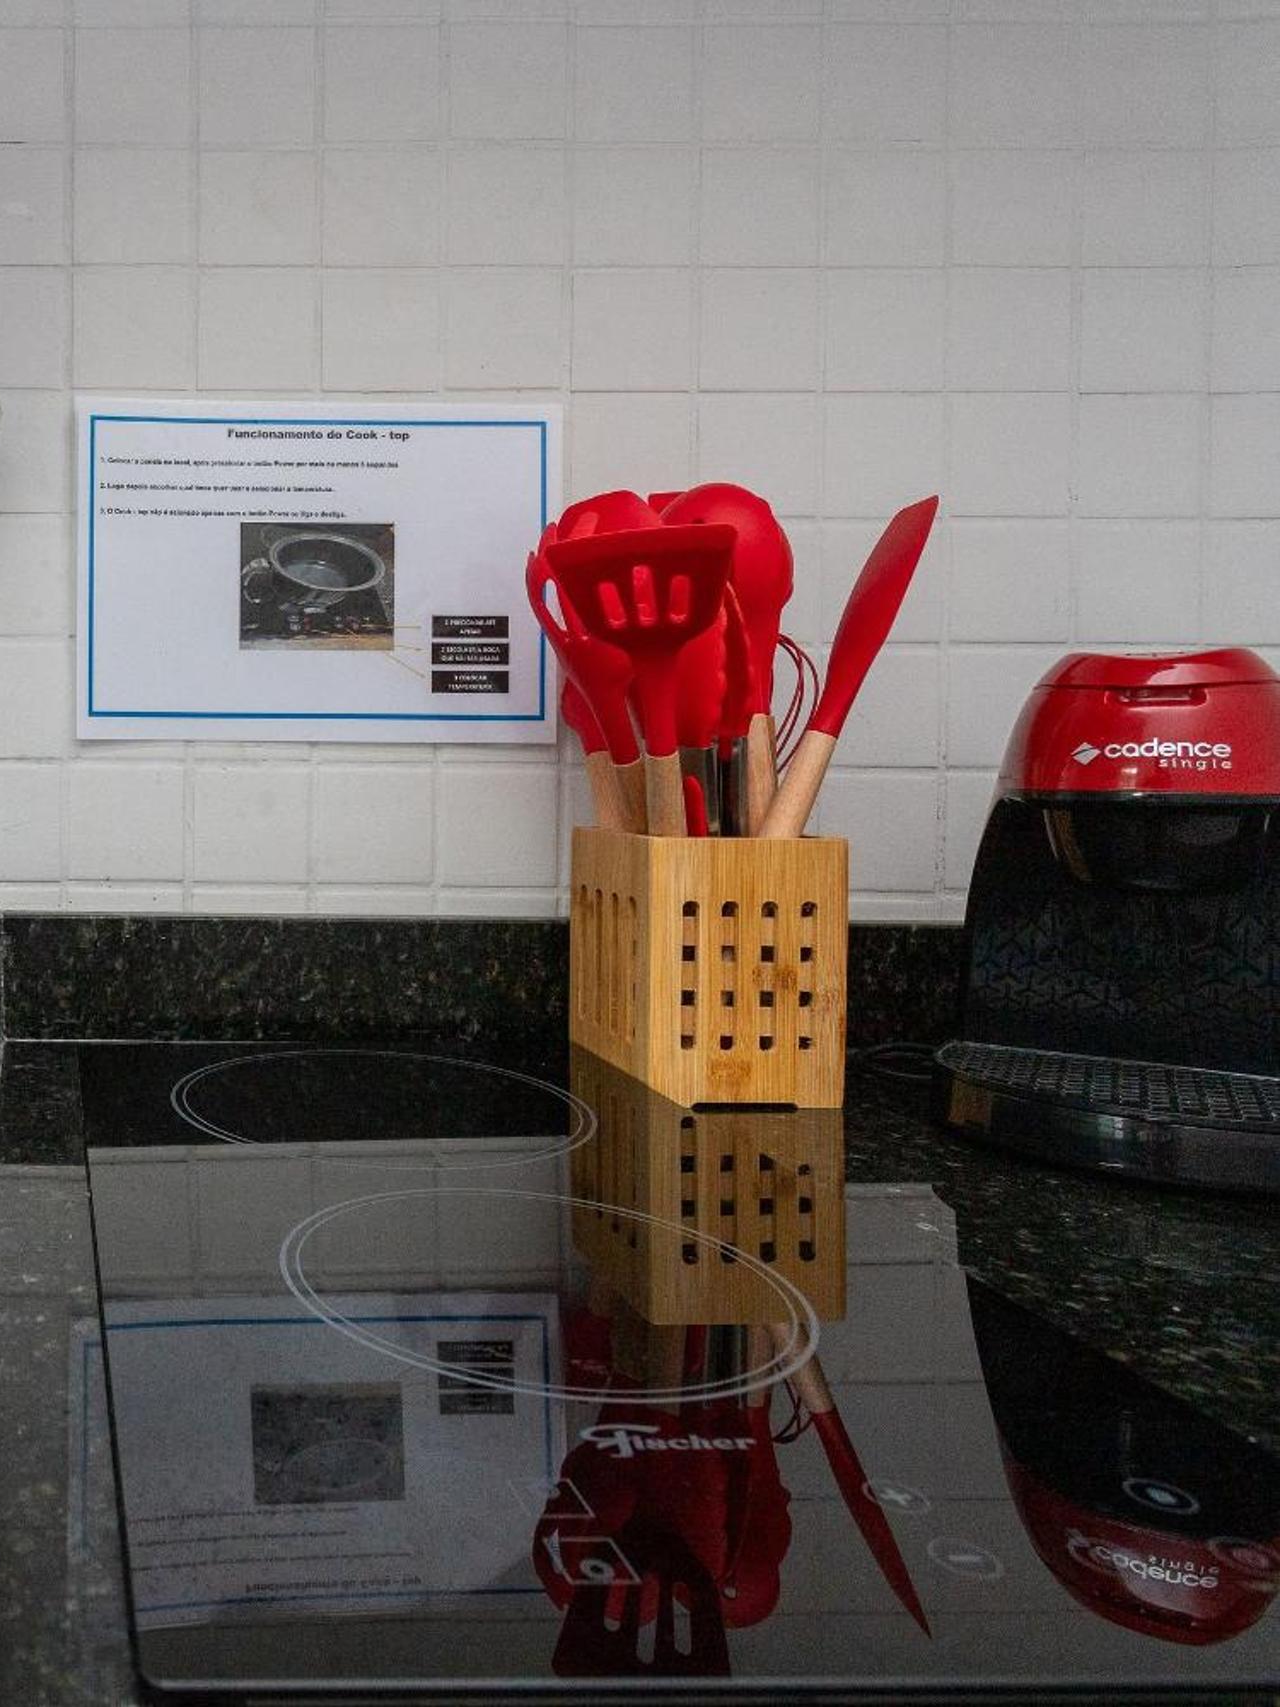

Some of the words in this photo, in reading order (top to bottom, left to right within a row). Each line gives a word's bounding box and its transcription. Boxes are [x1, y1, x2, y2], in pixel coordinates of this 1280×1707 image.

[227, 428, 323, 440] Funcionamento
[327, 430, 343, 440] do
[346, 430, 378, 440] Cook
[389, 431, 410, 442] top
[1104, 737, 1232, 758] cadence
[1158, 758, 1232, 771] single
[578, 1423, 757, 1458] Fischer
